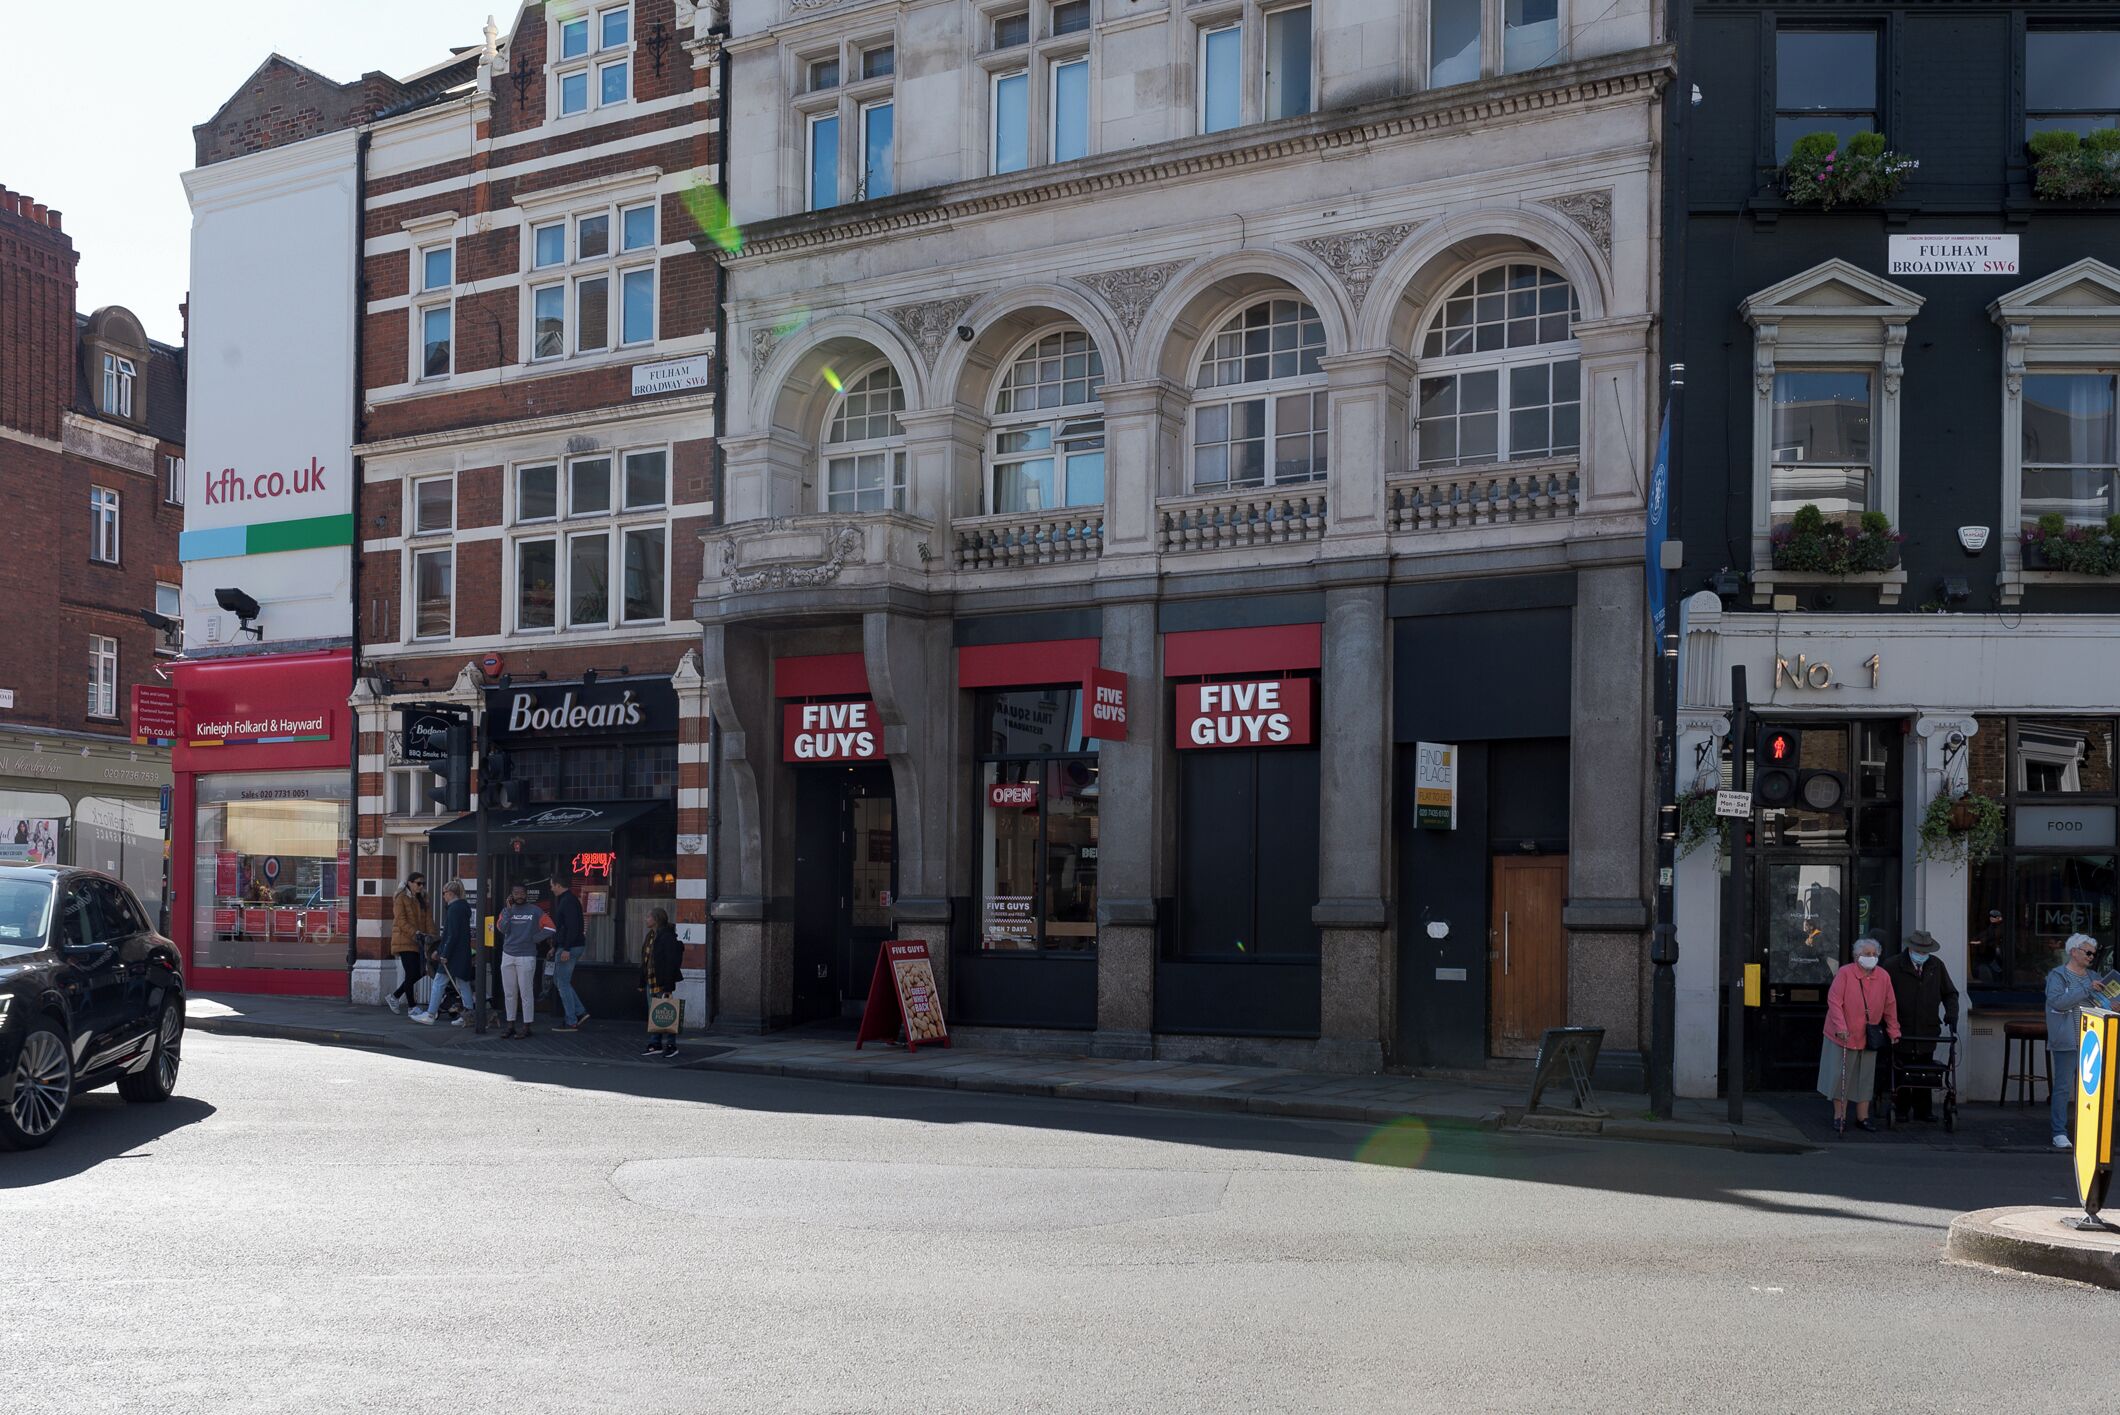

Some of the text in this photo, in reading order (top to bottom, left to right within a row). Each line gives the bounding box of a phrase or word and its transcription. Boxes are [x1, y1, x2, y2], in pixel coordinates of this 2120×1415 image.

[1920, 245, 1988, 256] FULHAM
[1893, 261, 2015, 272] BROADWAY SW6
[650, 366, 689, 380] FULHAM
[634, 376, 705, 394] BROADWAY SW6
[205, 457, 326, 505] kfh.co.uk
[1863, 654, 1880, 689] 1
[1097, 686, 1122, 704] FIVE
[1200, 682, 1280, 712] FIVE
[509, 690, 641, 732] Bodean's
[803, 704, 866, 729] FIVE
[1094, 704, 1126, 722] GUYS
[140, 725, 175, 736] kfh.co.uk
[197, 716, 322, 737] Kinleigh Folkard & Hayward
[1191, 713, 1290, 744] GUYS
[794, 732, 874, 758] GUYS
[408, 750, 421, 758] BBQ
[1420, 749, 1442, 766] FIND
[104, 768, 118, 778] 020
[120, 770, 138, 780] 7736
[1420, 766, 1451, 783] PLACE
[241, 789, 309, 799] Sales 020 7731 0051
[993, 788, 1032, 802] OPEN
[2048, 822, 2082, 832] FOOD
[2045, 910, 2085, 925] McG
[892, 945, 925, 954] FIVE GUYS
[914, 1003, 930, 1012] BACK
